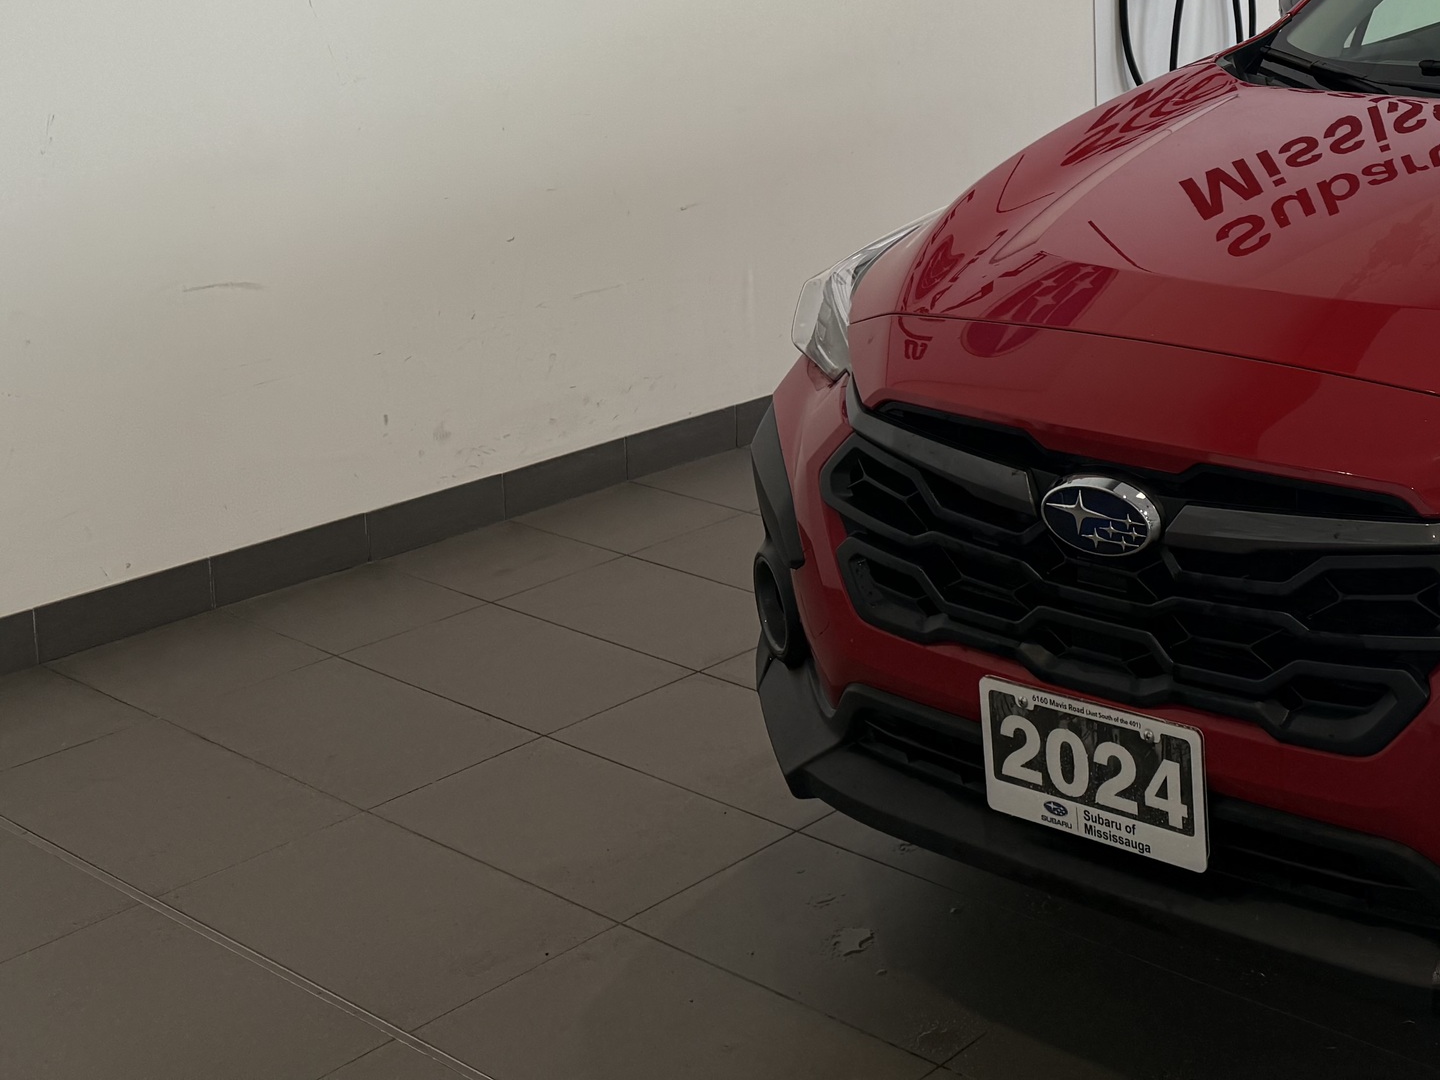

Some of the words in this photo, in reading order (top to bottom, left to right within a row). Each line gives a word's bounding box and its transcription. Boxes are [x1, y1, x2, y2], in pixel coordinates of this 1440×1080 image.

[1032, 695, 1048, 705] 6160
[1049, 699, 1067, 710] Mavis
[1068, 704, 1084, 714] Road
[1099, 712, 1113, 721] South
[1000, 715, 1188, 829] 2024
[1041, 814, 1072, 829] SUBARU
[1083, 810, 1121, 831] Subaru
[1125, 824, 1136, 835] of
[1084, 823, 1151, 854] Mississauga
